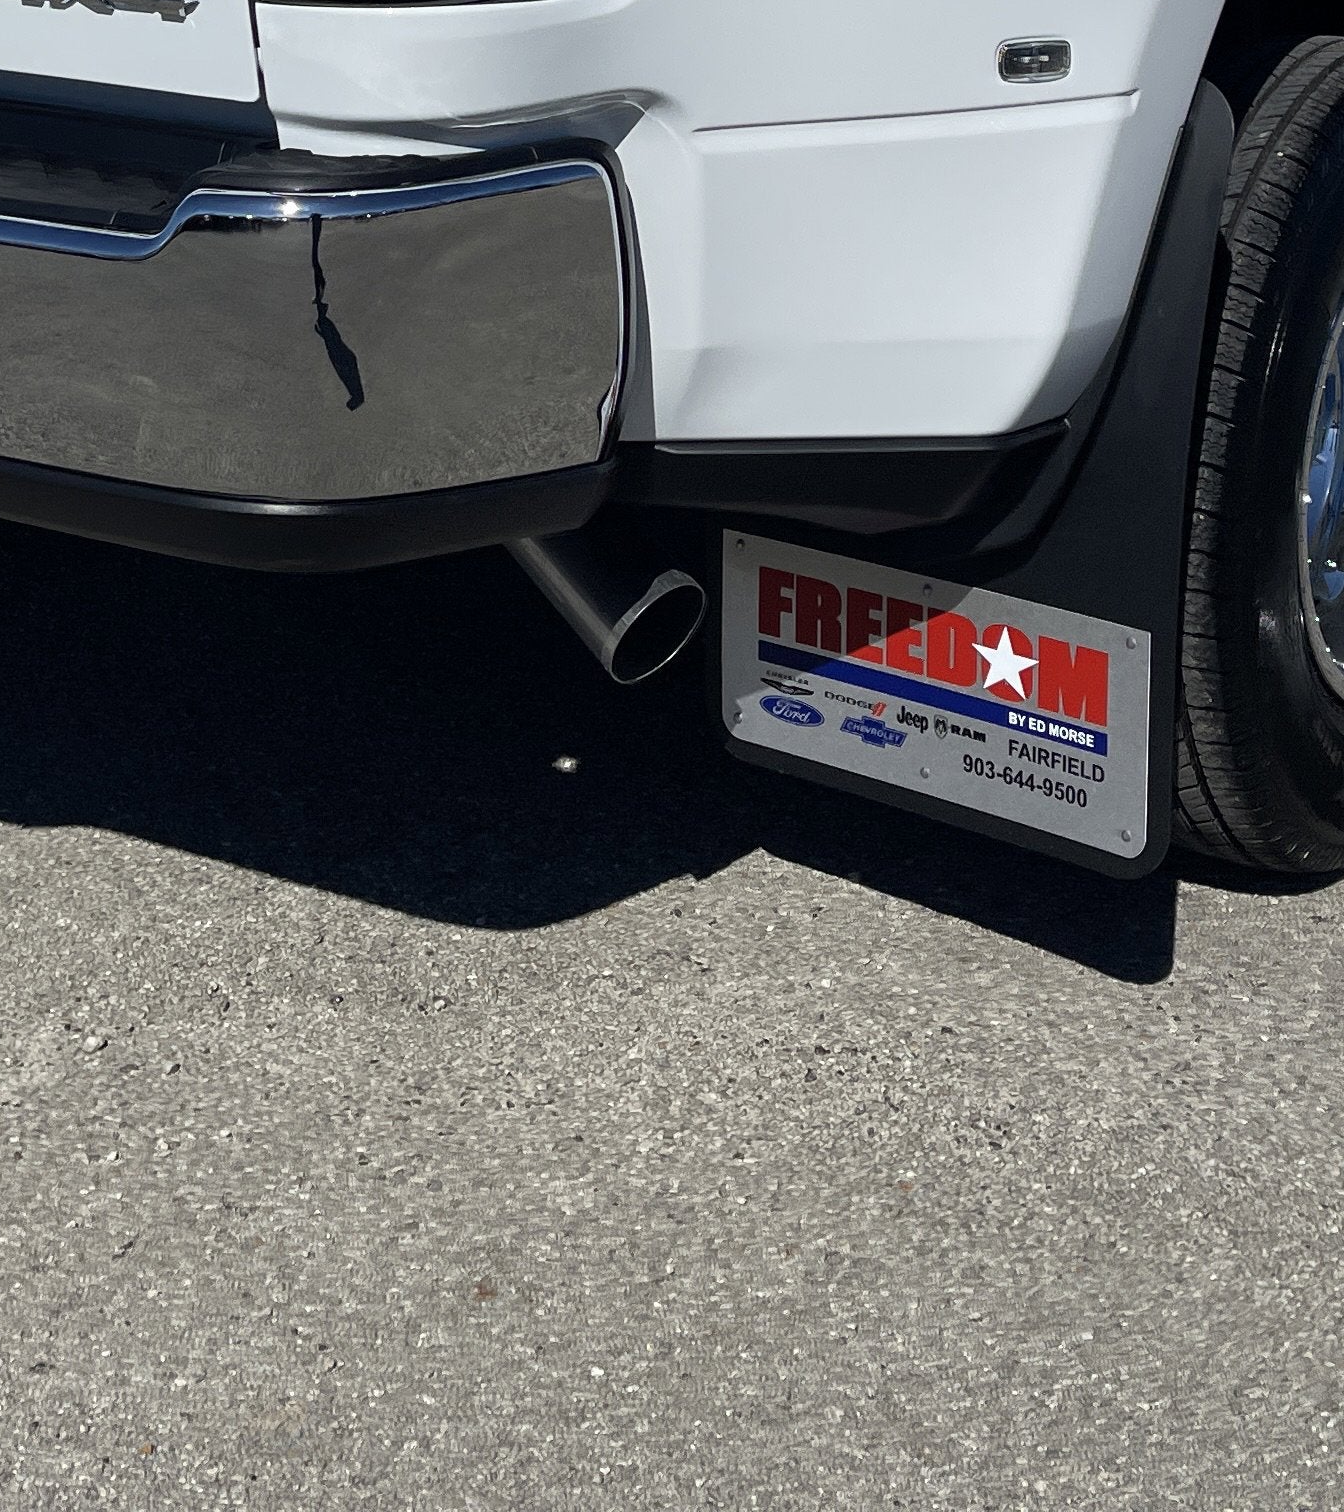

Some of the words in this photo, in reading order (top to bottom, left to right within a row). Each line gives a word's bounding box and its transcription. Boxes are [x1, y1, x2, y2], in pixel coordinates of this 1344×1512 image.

[759, 566, 1109, 727] FREEDOM
[772, 698, 811, 723] Ford
[896, 705, 928, 733] Jeep
[845, 720, 902, 745] CHEVROLET
[950, 724, 987, 743] RAM
[1008, 711, 1026, 727] BY
[1028, 717, 1046, 733] ED
[1049, 722, 1095, 748] MORSE
[1008, 739, 1105, 783] FAIRFIELD
[963, 754, 1087, 808] 903-644-9500
